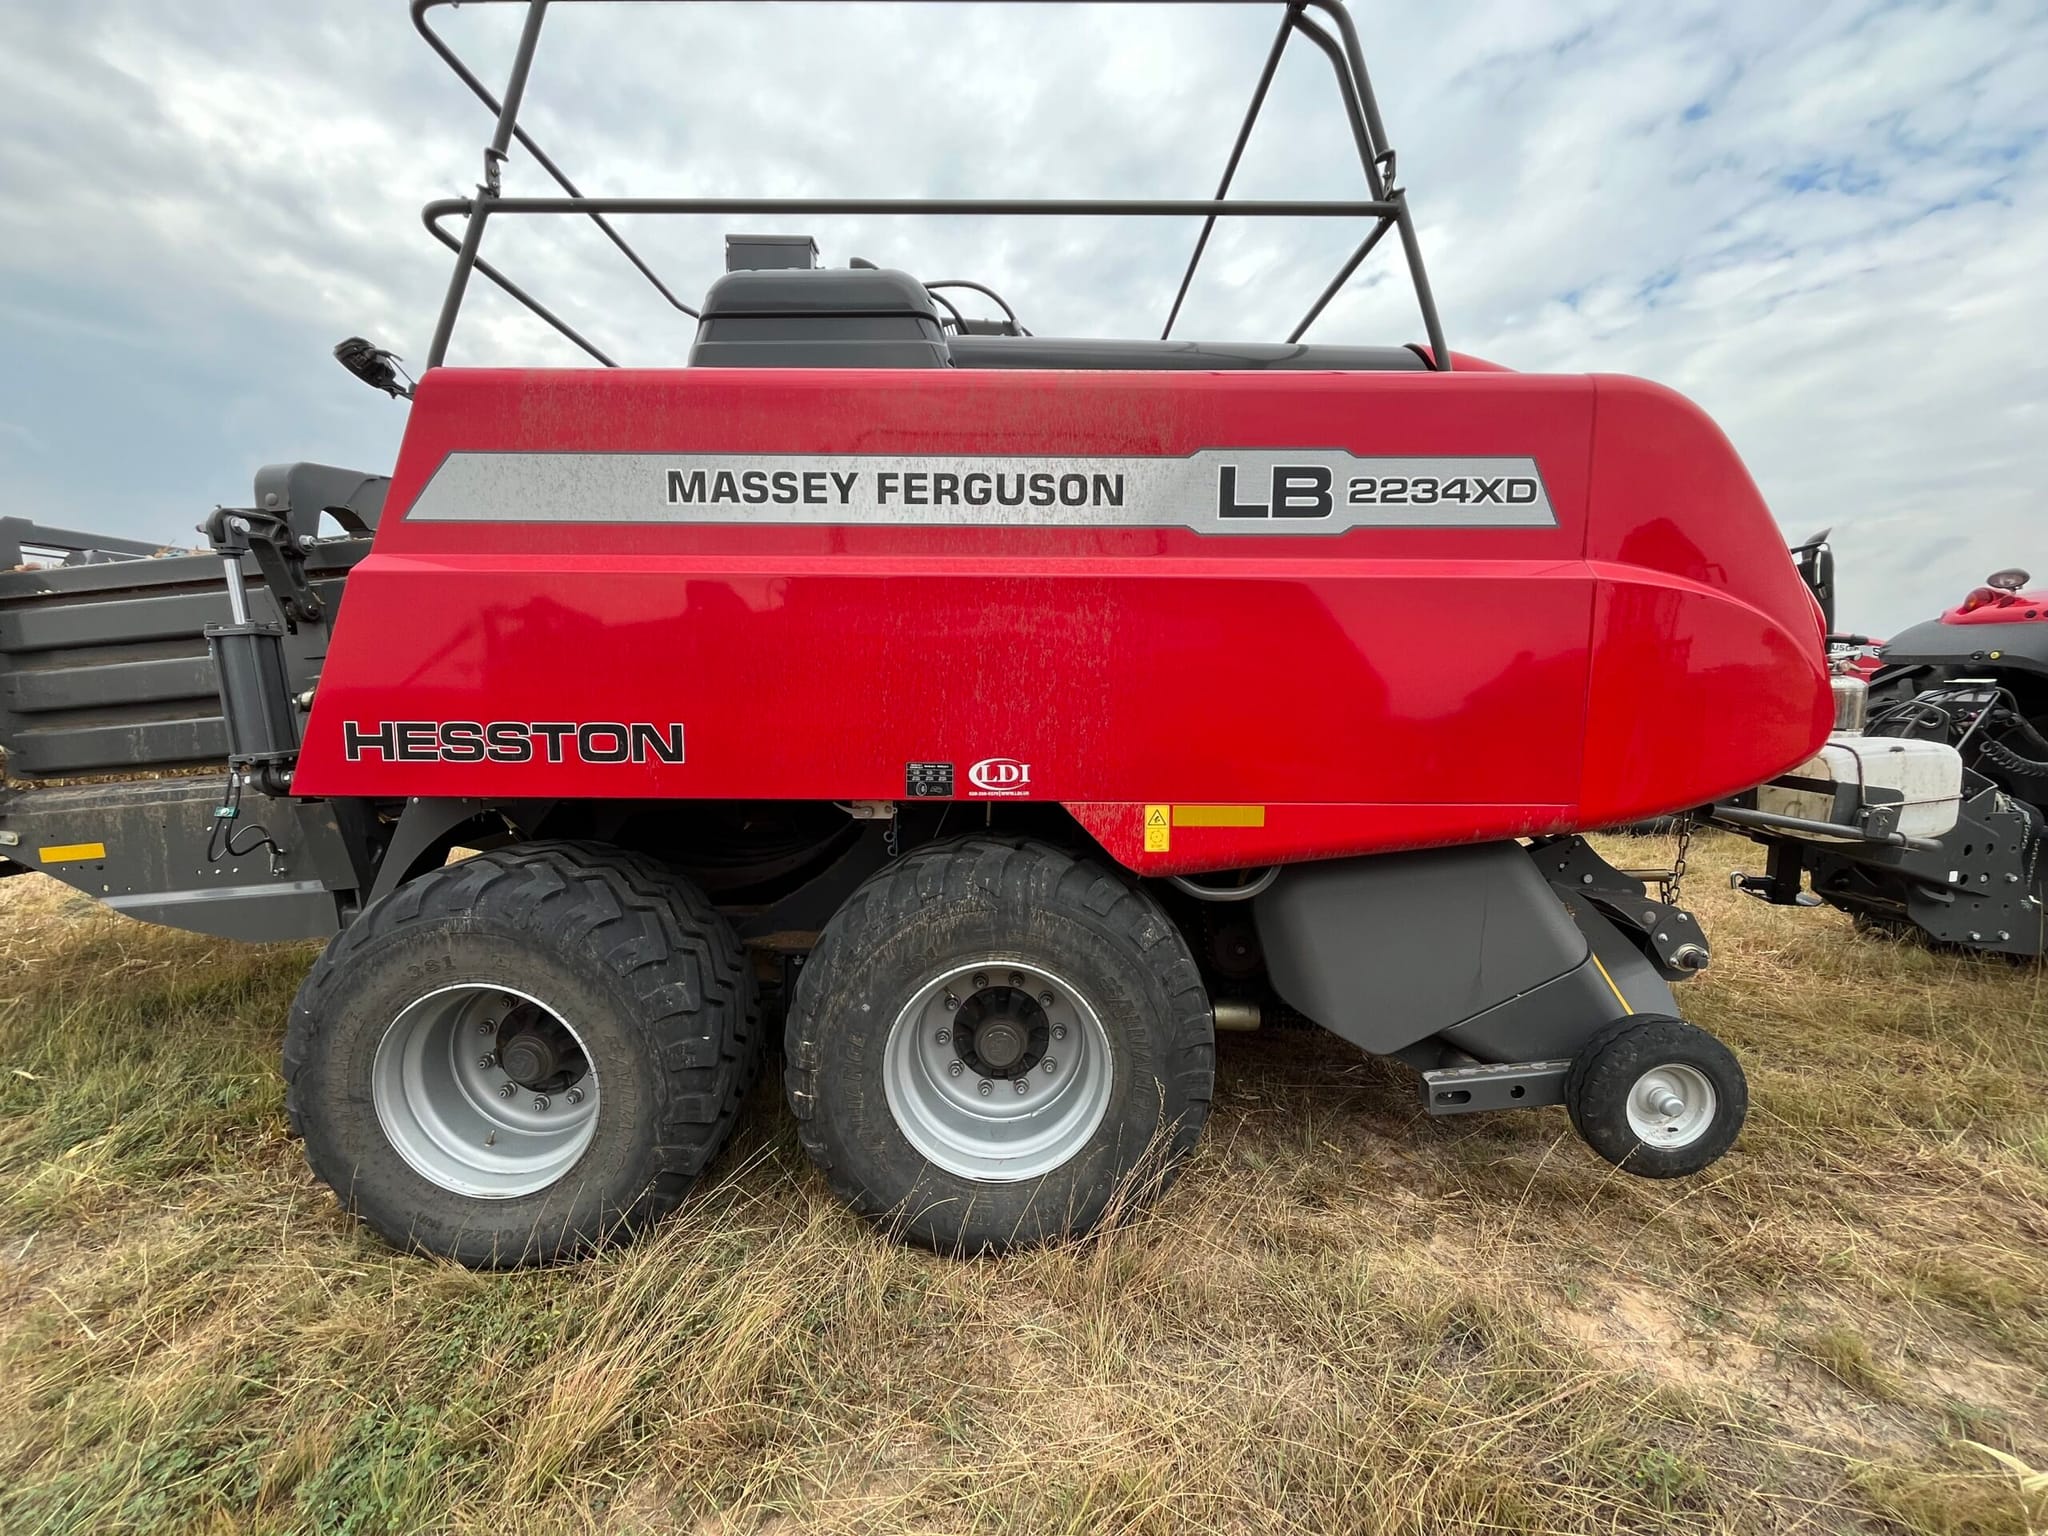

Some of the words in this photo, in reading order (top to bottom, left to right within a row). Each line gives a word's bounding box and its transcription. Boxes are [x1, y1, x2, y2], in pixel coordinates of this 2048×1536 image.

[666, 469, 860, 505] MASSEY
[877, 471, 1125, 507] FERGUSON
[1217, 465, 1334, 519] LB
[1348, 476, 1538, 505] 2234XD
[342, 720, 686, 765] HESSTON
[980, 764, 1031, 783] LDI
